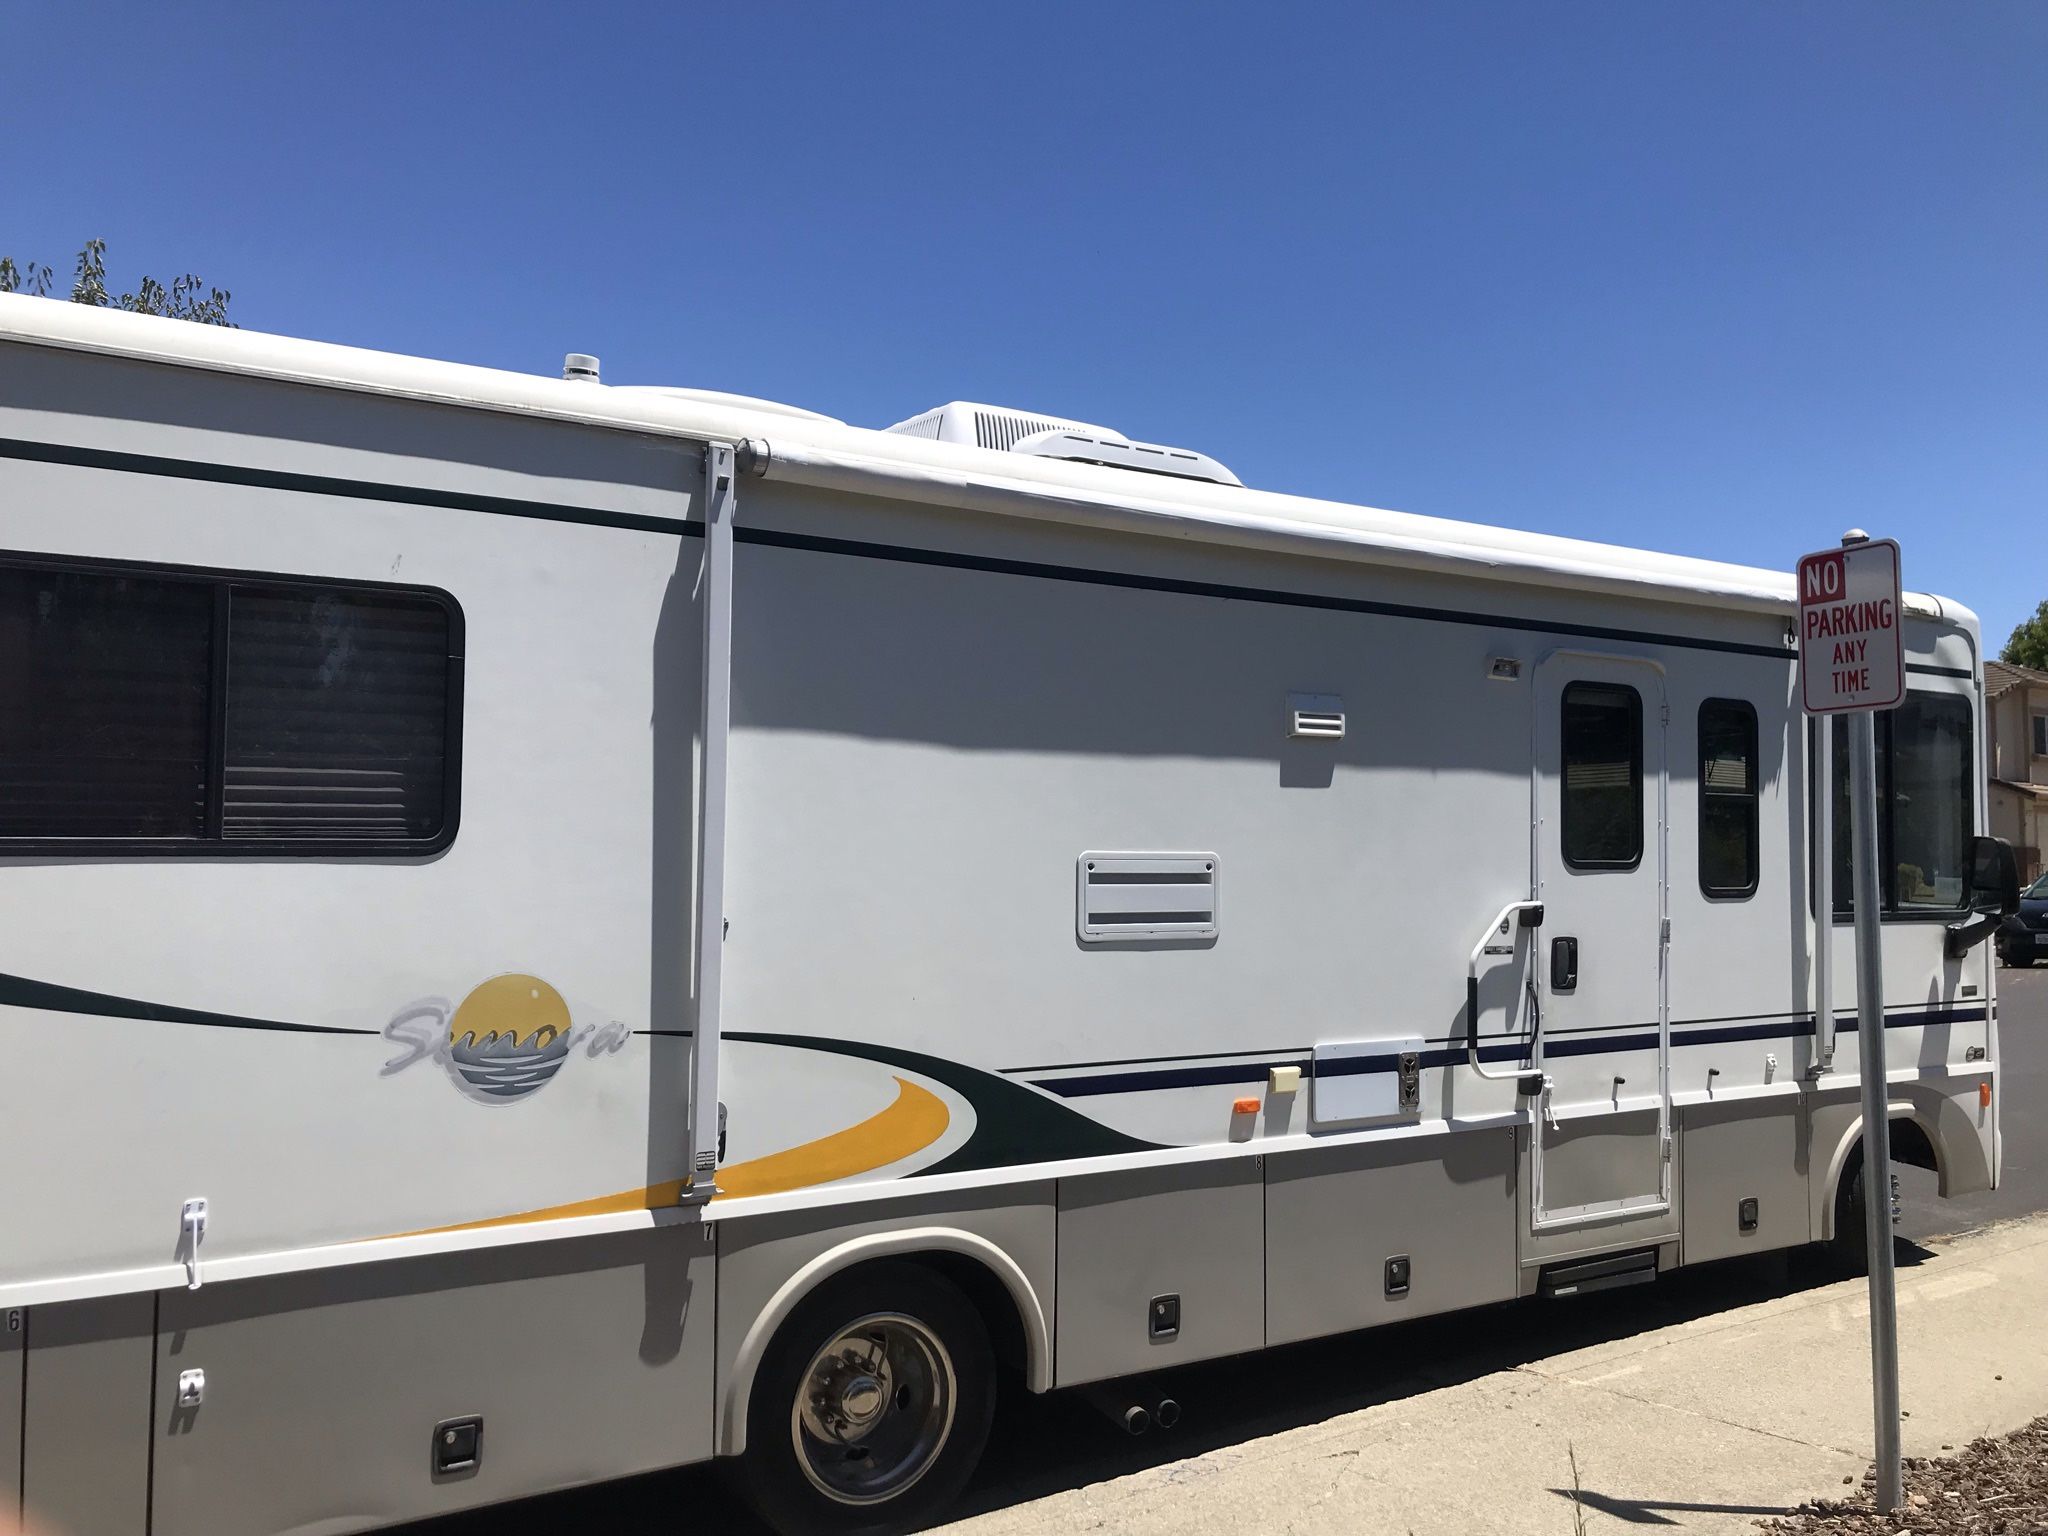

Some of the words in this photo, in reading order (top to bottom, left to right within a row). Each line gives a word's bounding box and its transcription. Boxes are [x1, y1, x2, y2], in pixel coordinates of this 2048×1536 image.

[1805, 560, 1839, 598] NO
[1807, 599, 1892, 640] PARKING
[1833, 639, 1867, 665] ANY
[1832, 668, 1870, 694] TIME
[1256, 1155, 1262, 1170] 8
[705, 1223, 712, 1240] 7
[9, 1310, 20, 1331] 6
